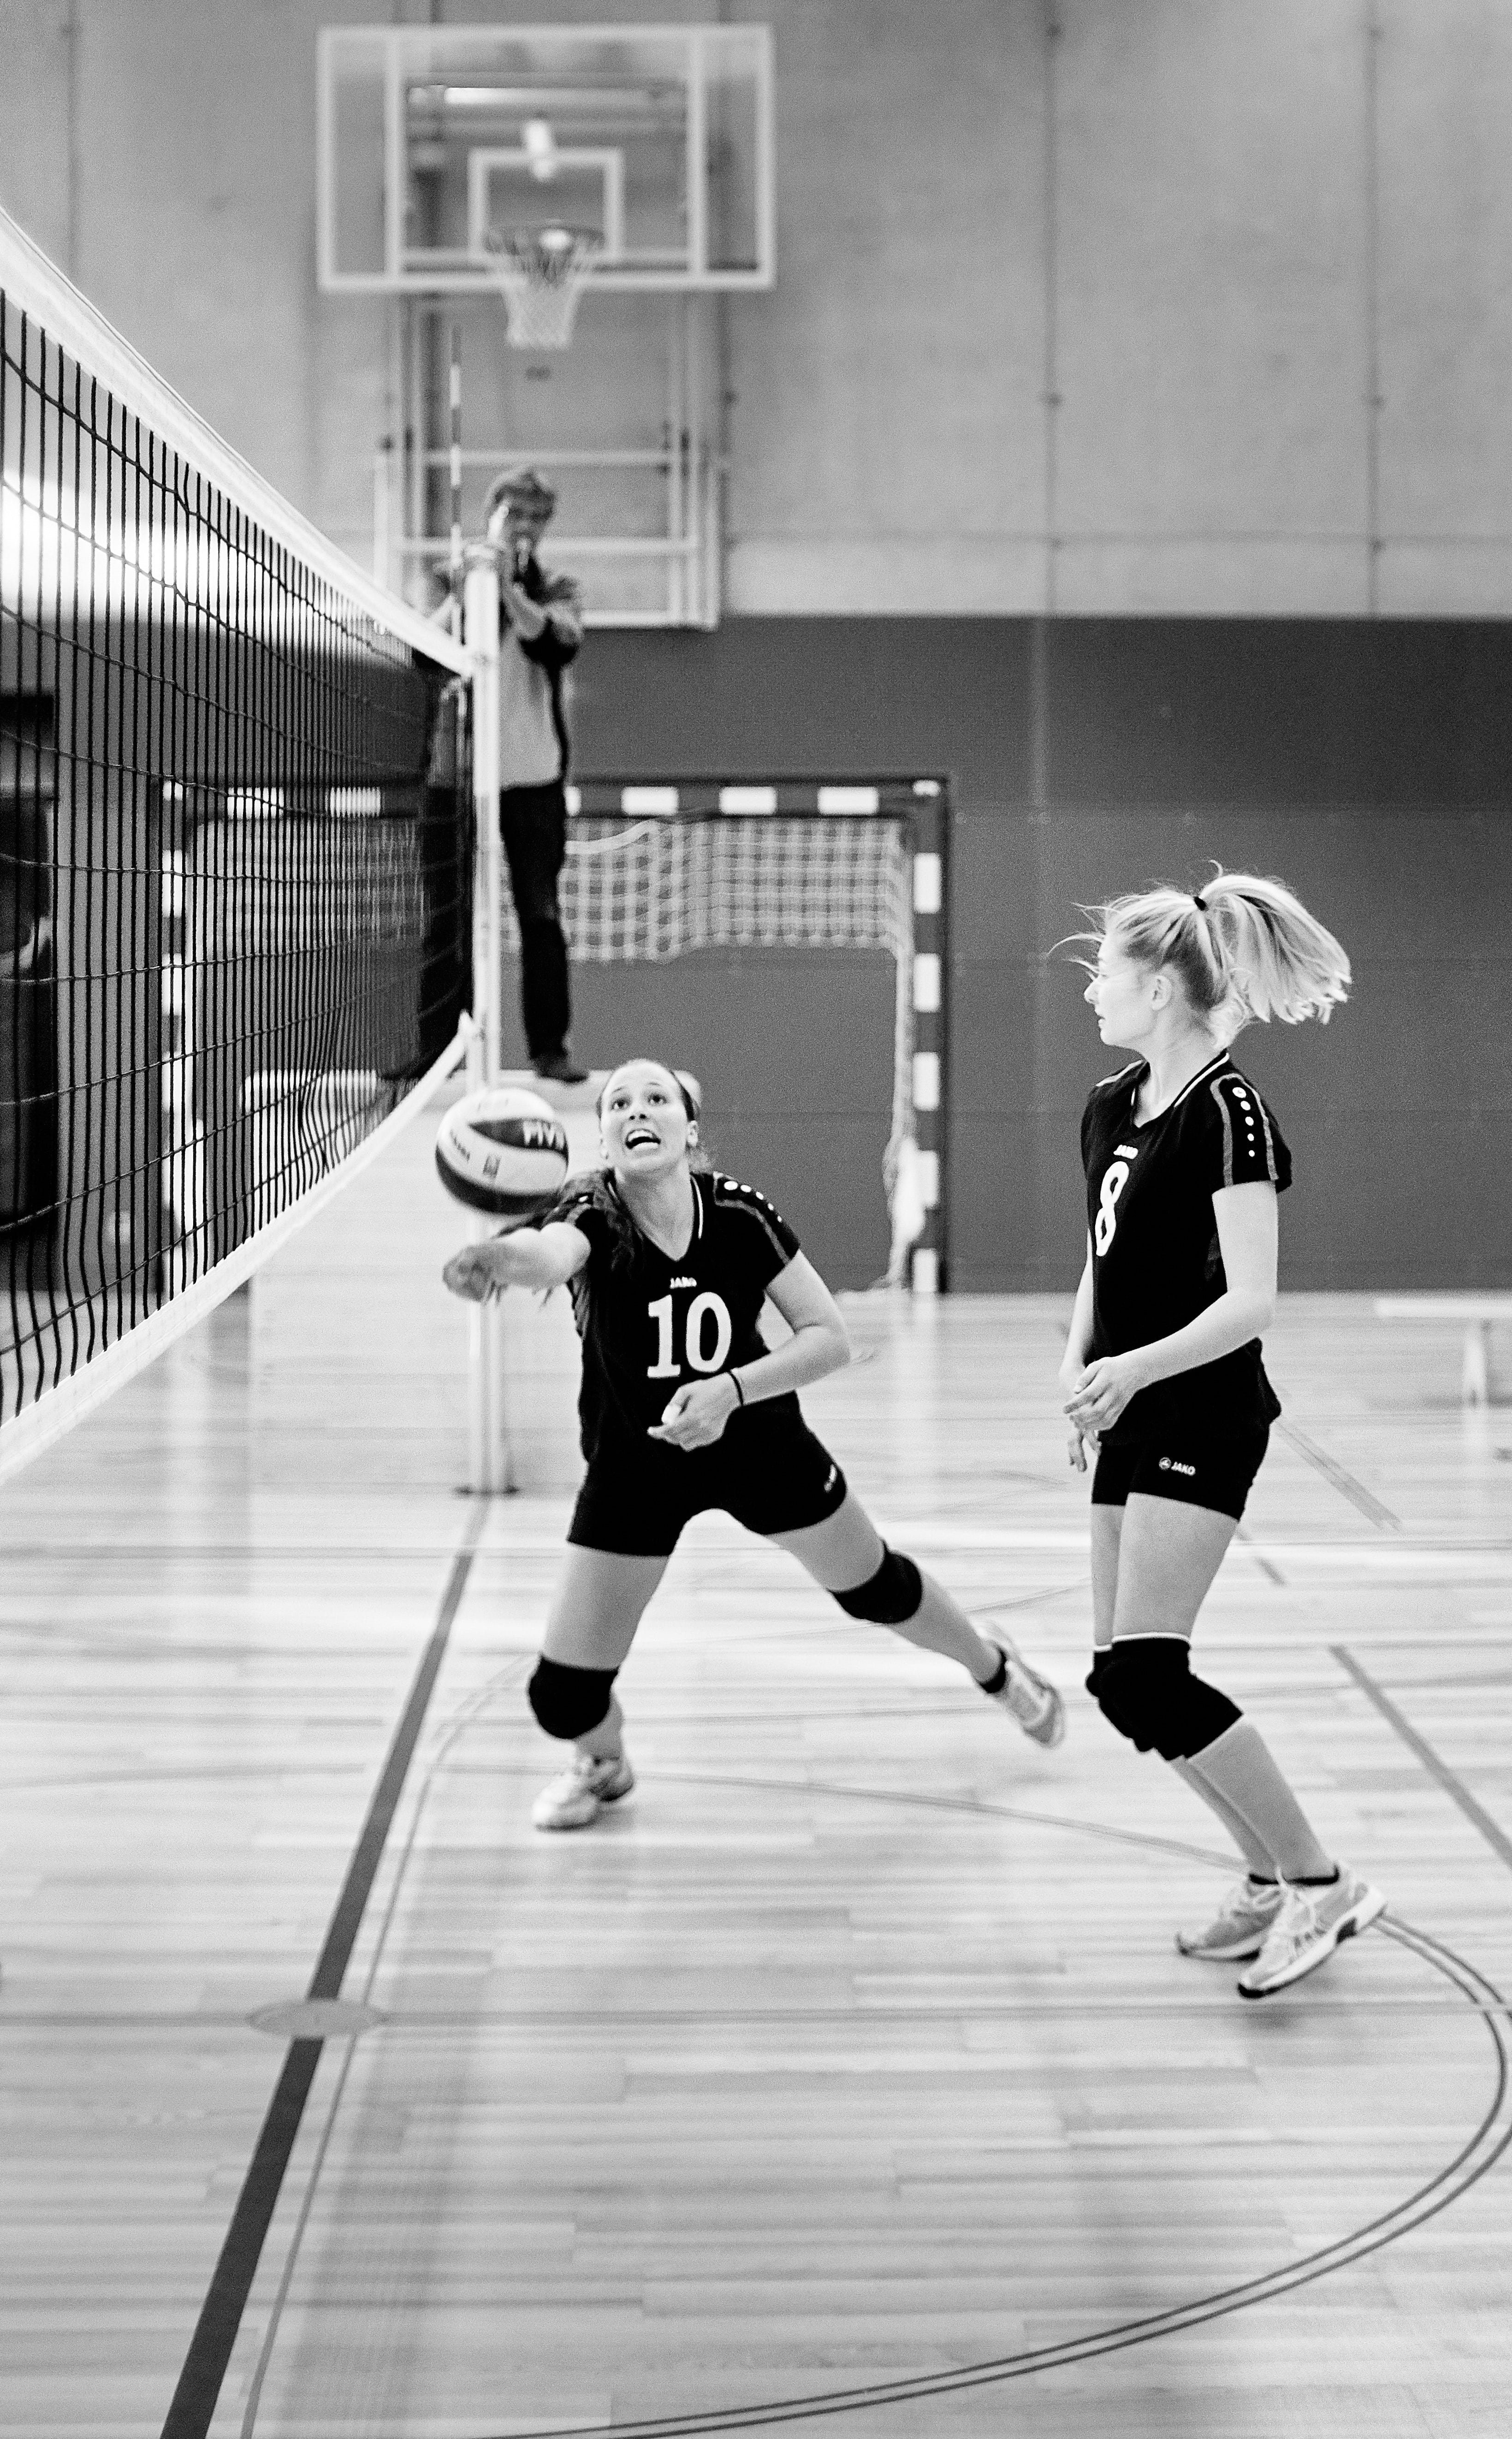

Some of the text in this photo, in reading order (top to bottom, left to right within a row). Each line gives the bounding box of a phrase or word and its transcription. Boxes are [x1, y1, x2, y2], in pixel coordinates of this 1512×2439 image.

[1095, 1161, 1129, 1257] 8
[647, 1292, 732, 1378] 10
[1171, 1461, 1196, 1476] JAKO
